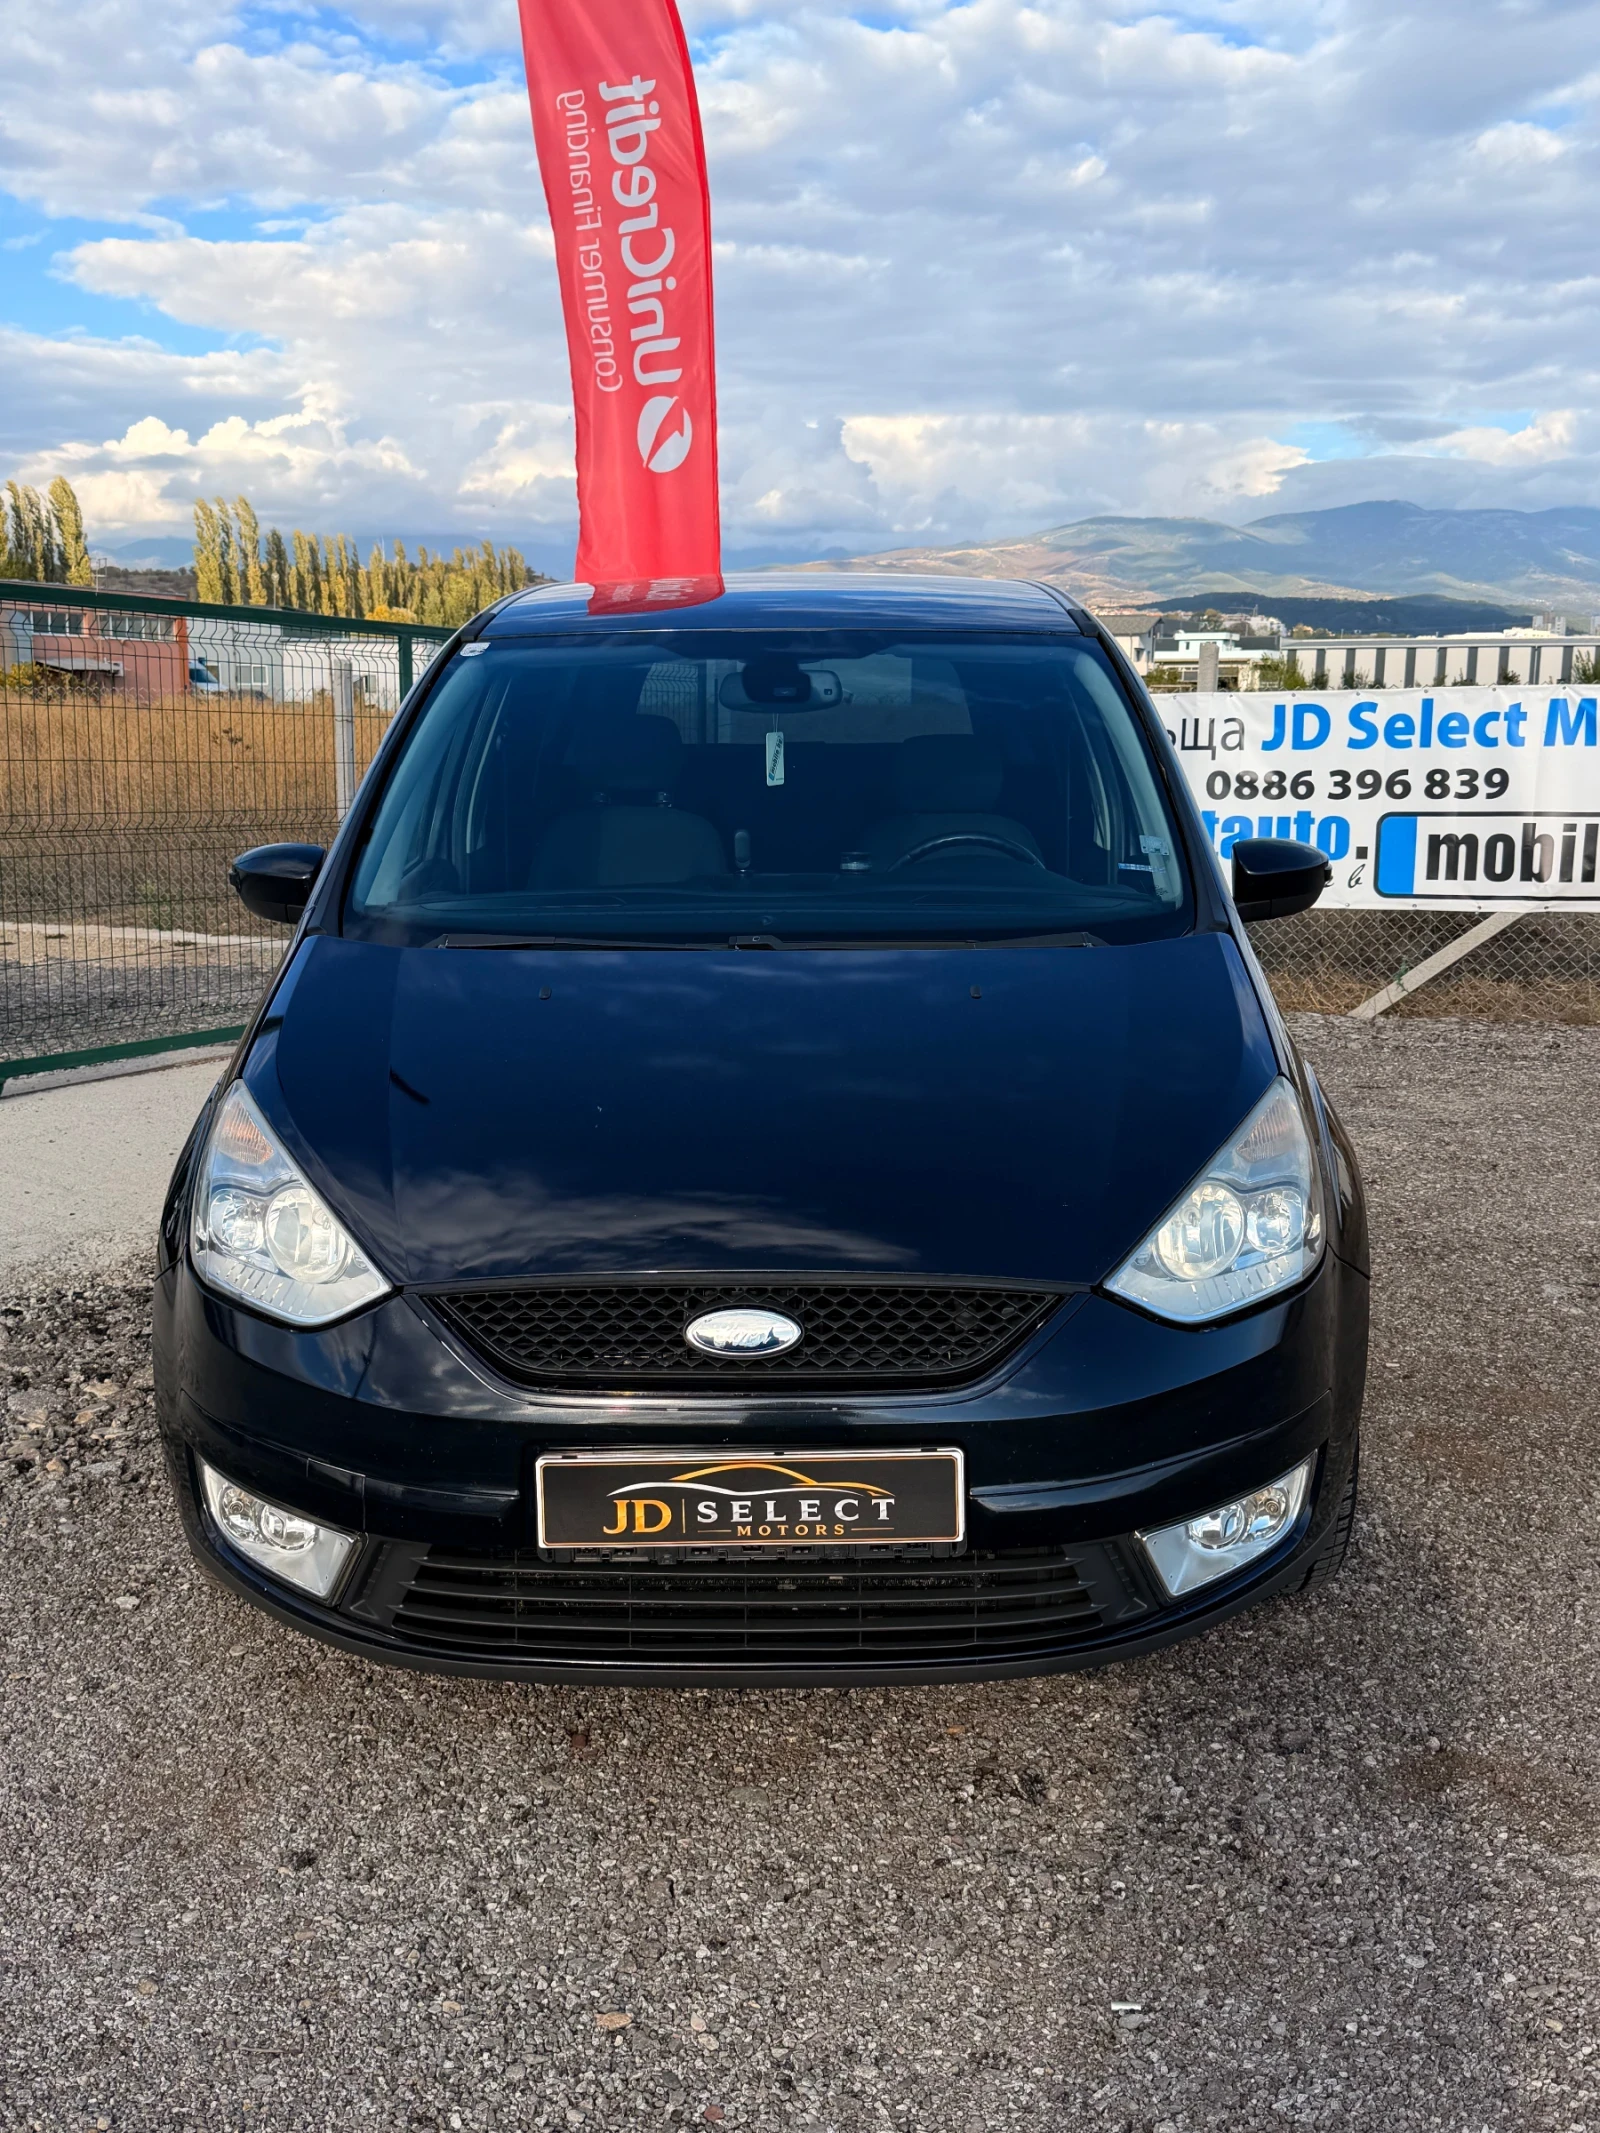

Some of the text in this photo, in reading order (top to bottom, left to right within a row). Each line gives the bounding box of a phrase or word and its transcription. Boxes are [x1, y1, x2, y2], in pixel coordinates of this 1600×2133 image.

[1261, 703, 1331, 751] JD
[1347, 698, 1528, 750] Select
[1543, 697, 1598, 747] M
[1206, 767, 1510, 801] 0886 396 839
[1425, 822, 1600, 883] mobil
[603, 1498, 896, 1535] JD SELECT
[736, 1523, 845, 1537] MOTORS
